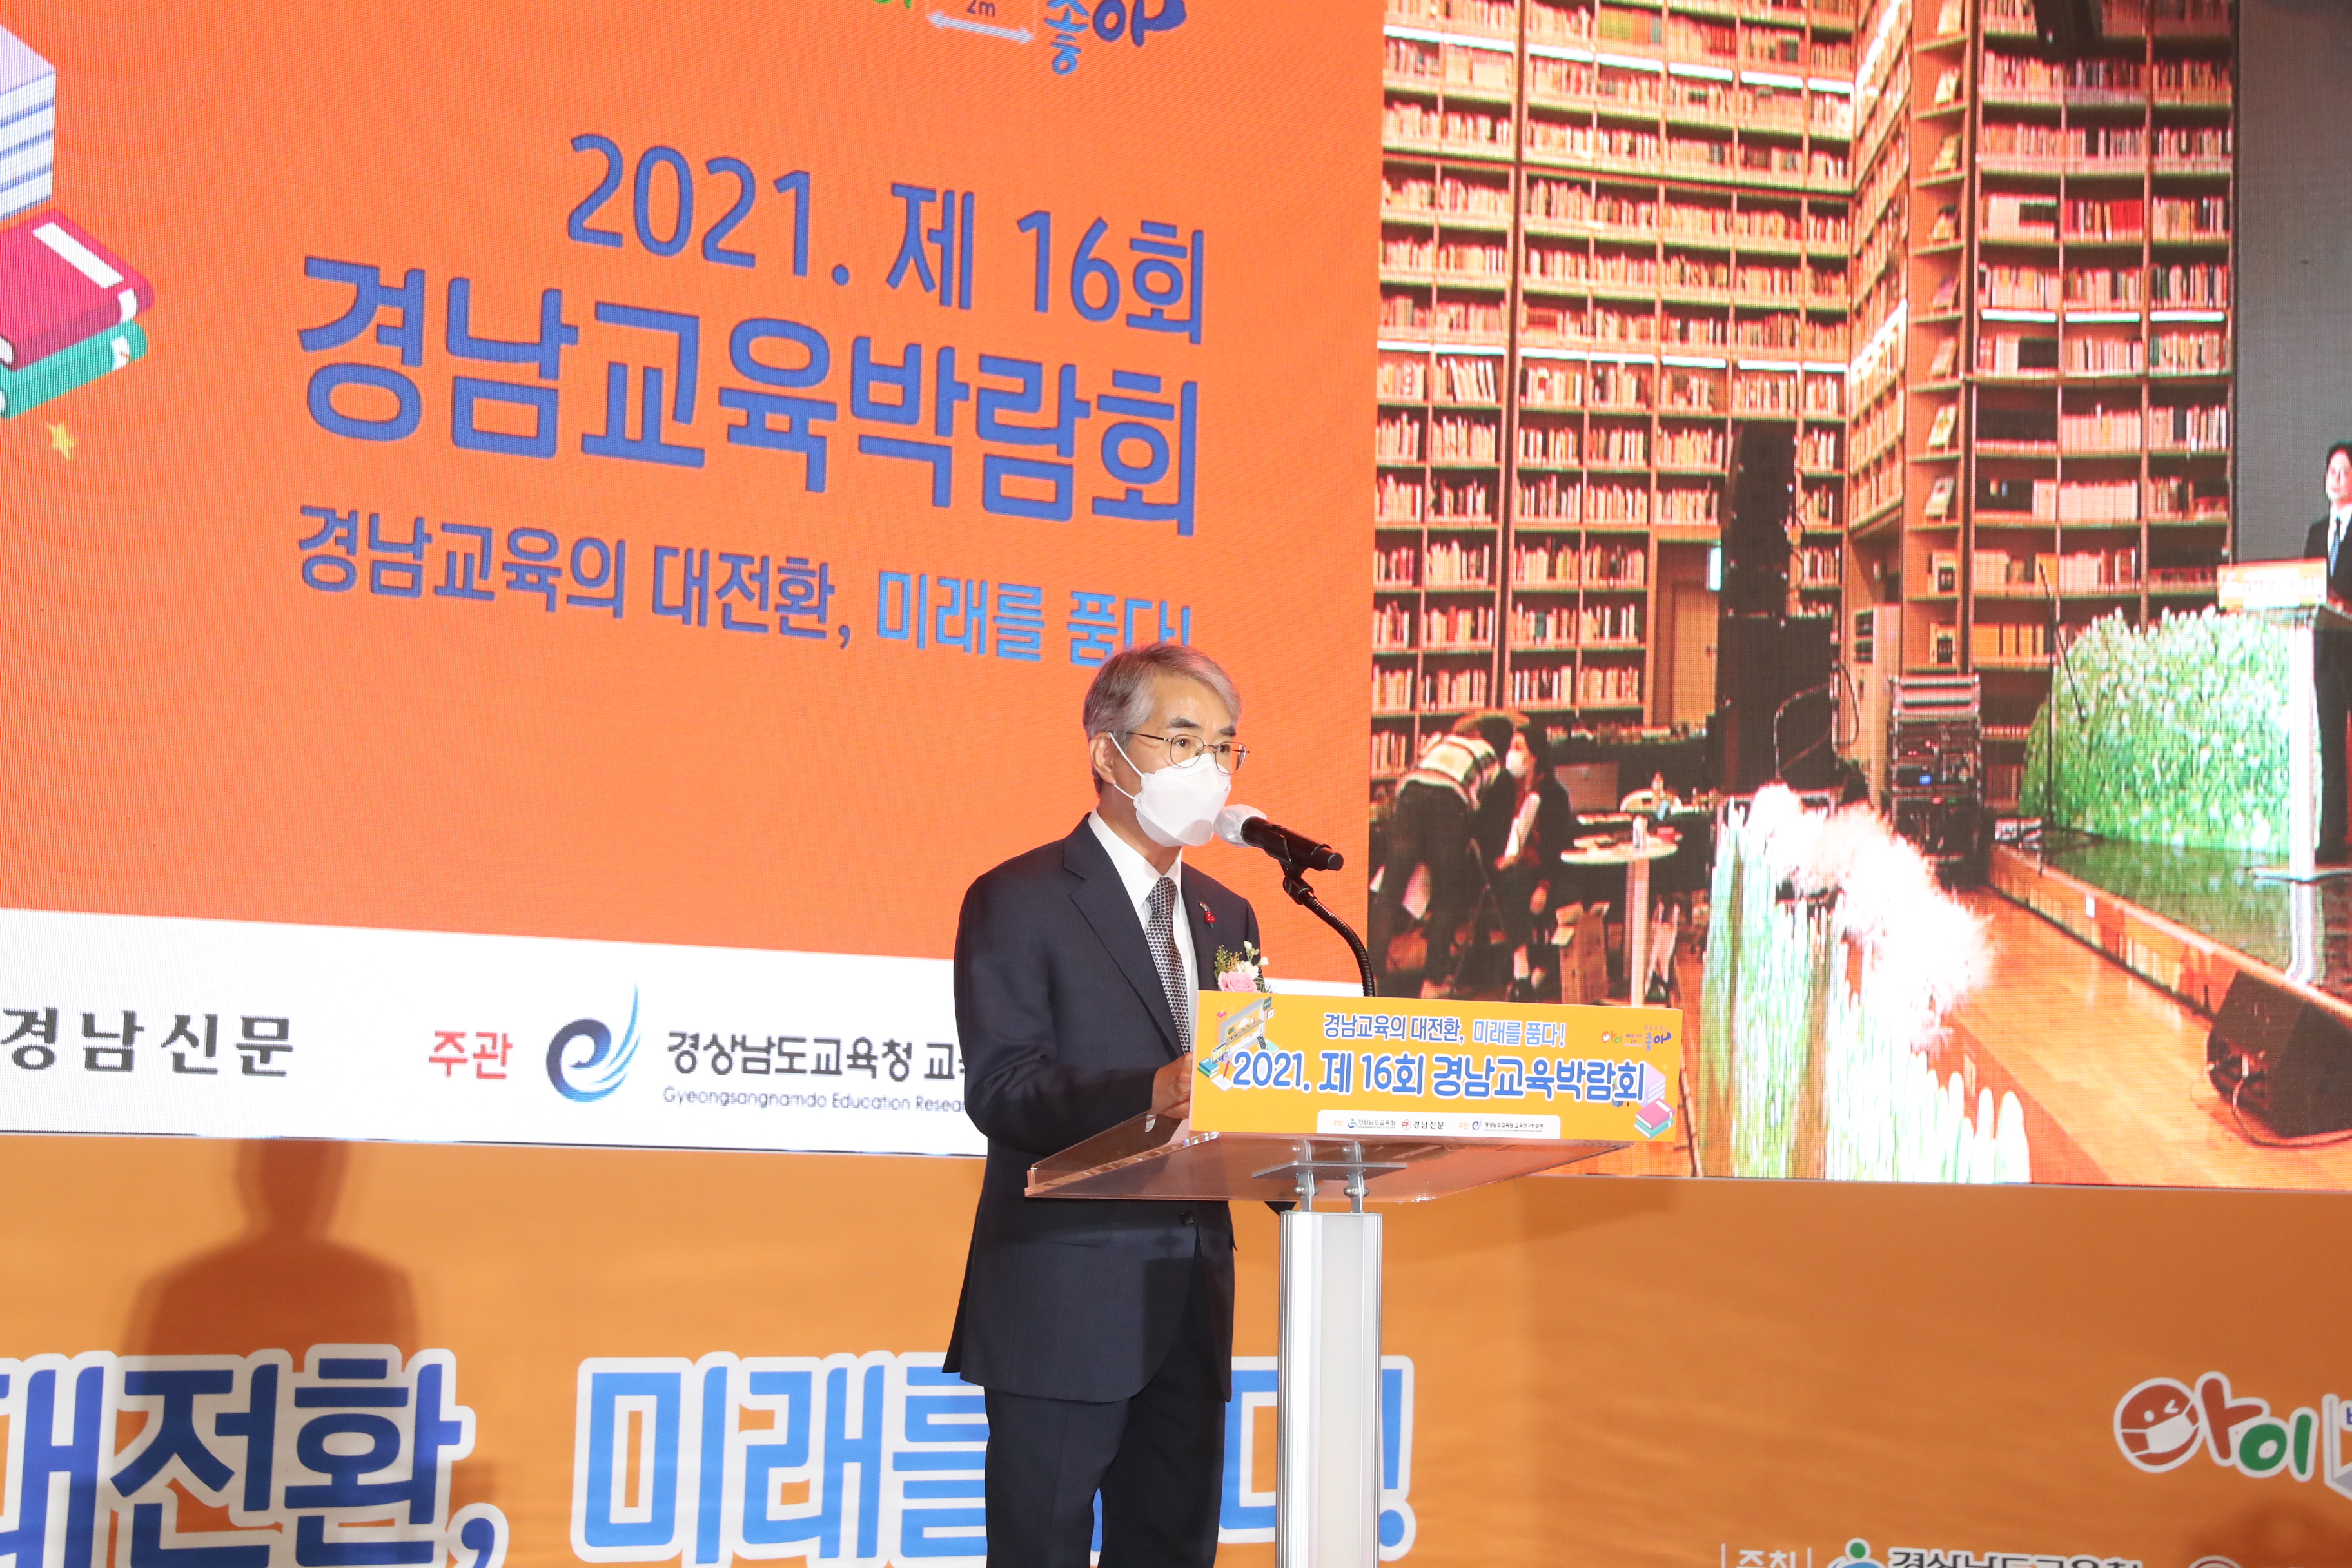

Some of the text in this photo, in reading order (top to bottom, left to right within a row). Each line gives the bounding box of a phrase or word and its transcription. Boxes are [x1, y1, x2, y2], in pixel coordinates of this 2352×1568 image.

[567, 133, 1204, 346] 2021. 제 16회
[297, 255, 1199, 538] 경남교육박람회
[297, 504, 627, 620] 경남교육의
[651, 544, 854, 651] 대전환,
[877, 570, 1046, 663] 미래를
[0, 1006, 294, 1077] 경남신문
[428, 1030, 513, 1081] 주관
[666, 1030, 913, 1083] 경상남도교육청
[1324, 1014, 1565, 1047] 경남교육의 대전환, 미래를 품다!
[662, 1084, 827, 1109] Gyeongsangnamdo
[832, 1092, 911, 1111] Education
[1232, 1050, 1645, 1101] 2021. 제 16회 경남교육박람회
[1413, 1121, 1444, 1130] 경남신문
